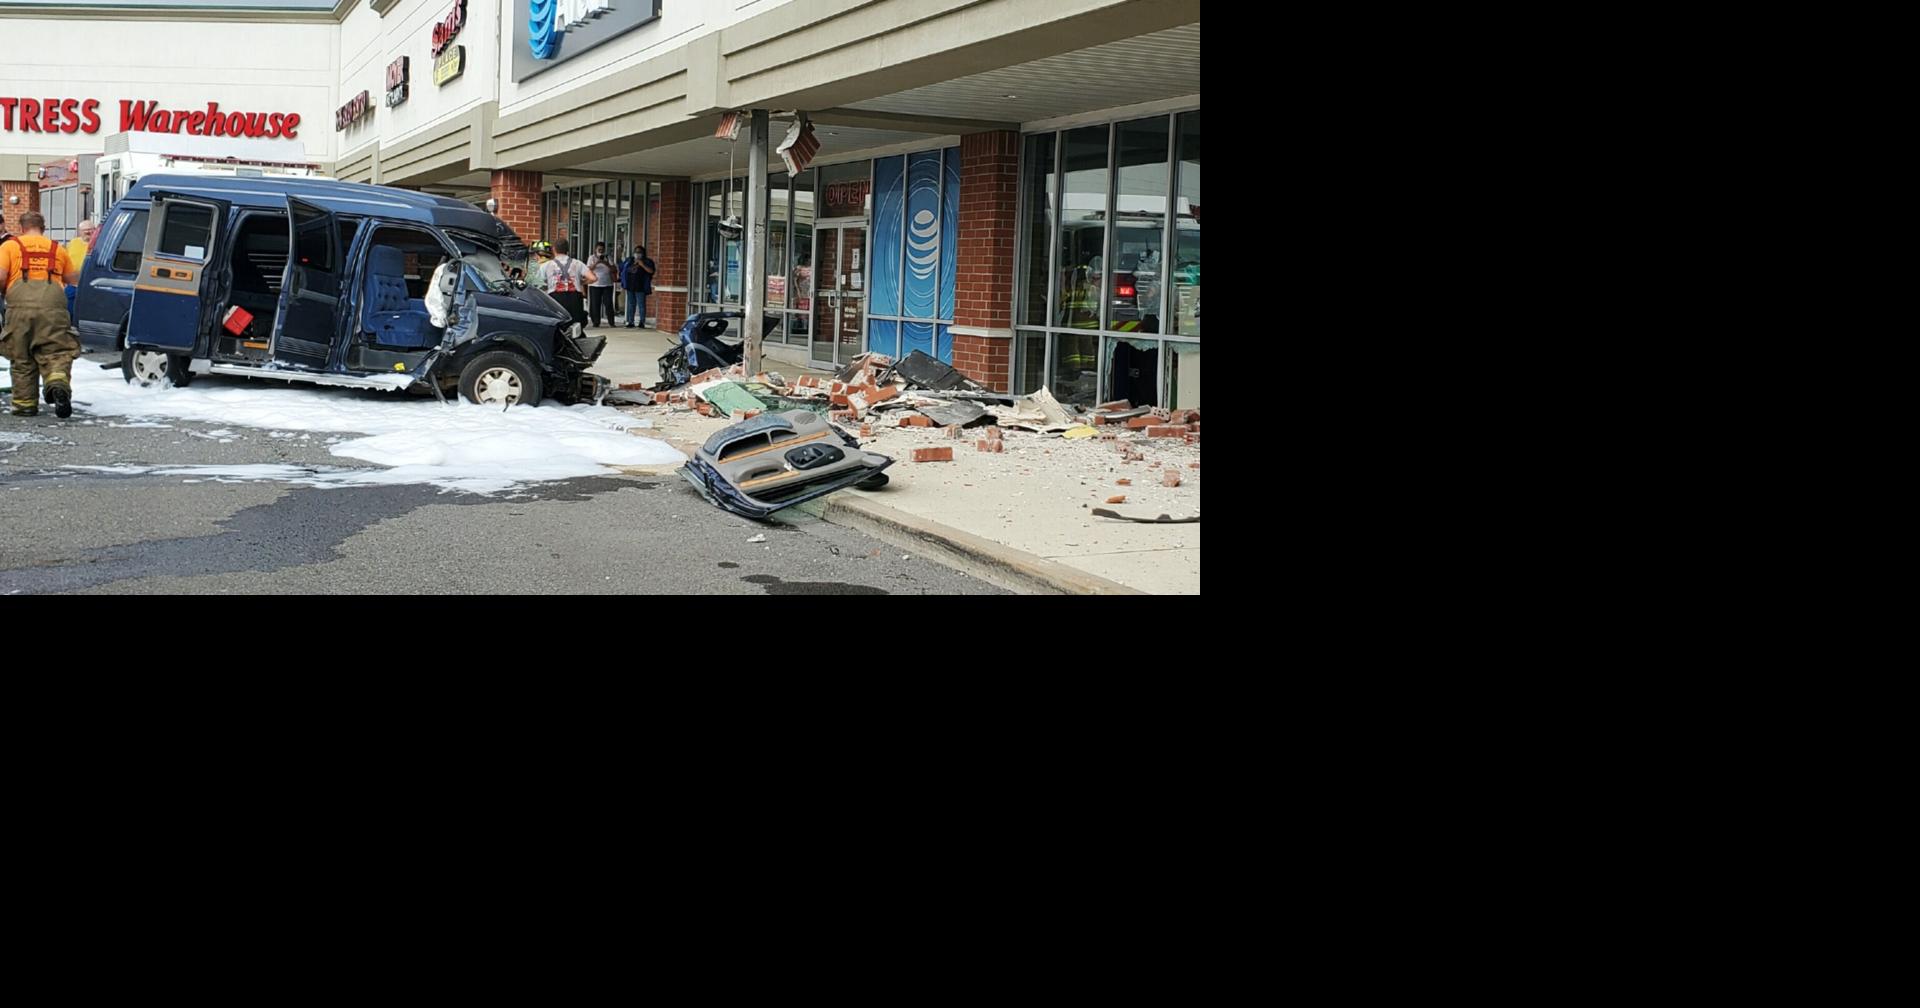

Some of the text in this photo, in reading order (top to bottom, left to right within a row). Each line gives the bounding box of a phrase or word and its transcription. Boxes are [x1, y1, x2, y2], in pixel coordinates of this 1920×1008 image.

[0, 97, 101, 134] TRESS
[119, 99, 300, 138] Warehouse
[826, 179, 871, 207] OPEN
